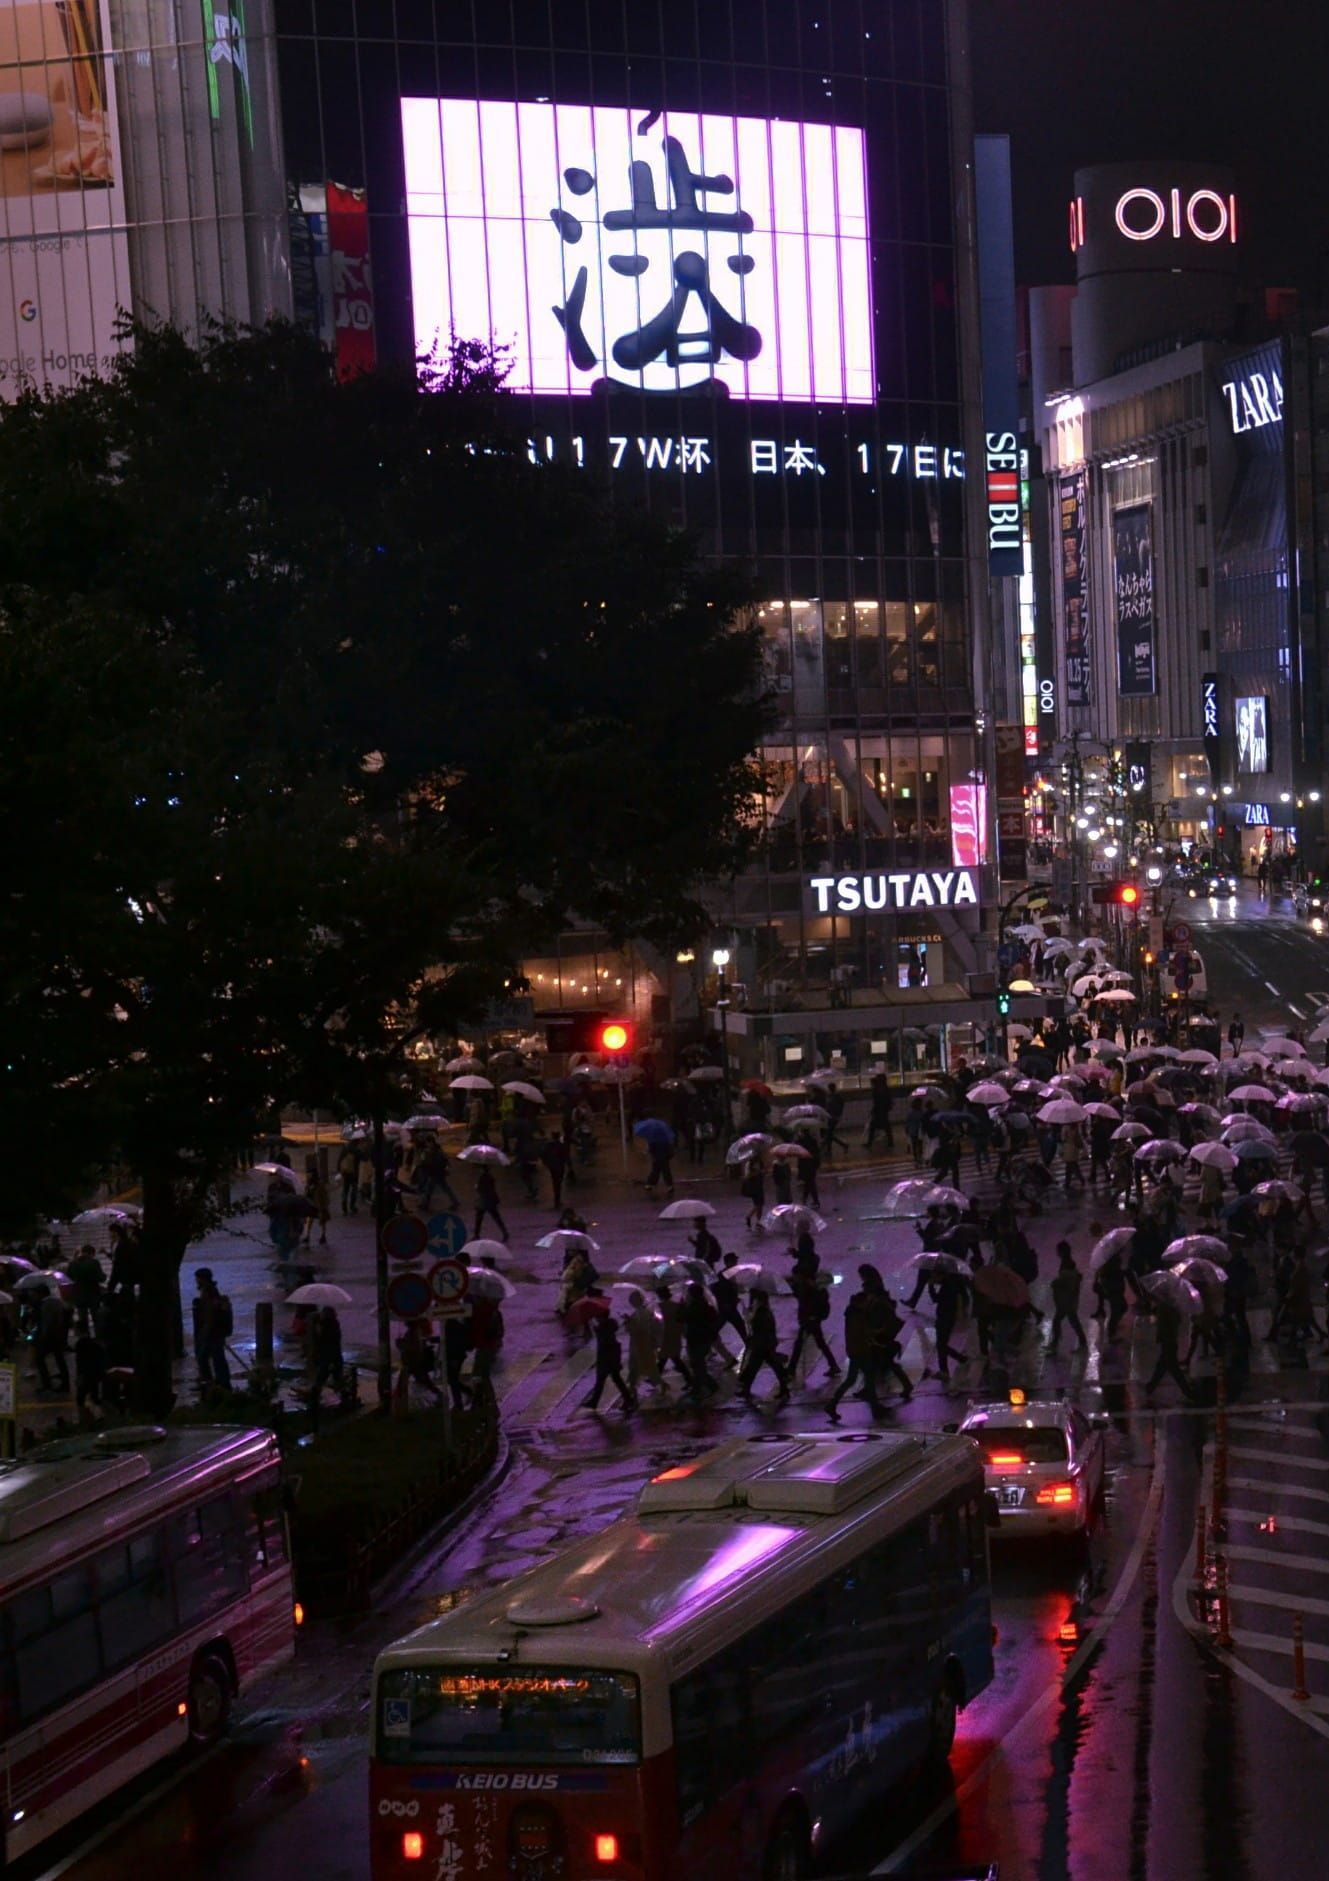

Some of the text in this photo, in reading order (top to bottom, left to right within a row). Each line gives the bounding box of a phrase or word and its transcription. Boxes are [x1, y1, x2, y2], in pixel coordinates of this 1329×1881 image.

[44, 349, 97, 371] Home
[1222, 371, 1285, 435] ZARA
[985, 431, 1020, 550] SEIBU
[1204, 682, 1217, 737] ZARA
[1245, 804, 1270, 825] ZARA
[810, 871, 977, 912] TSUTAYA
[456, 1773, 559, 1789] KEIO BUS
